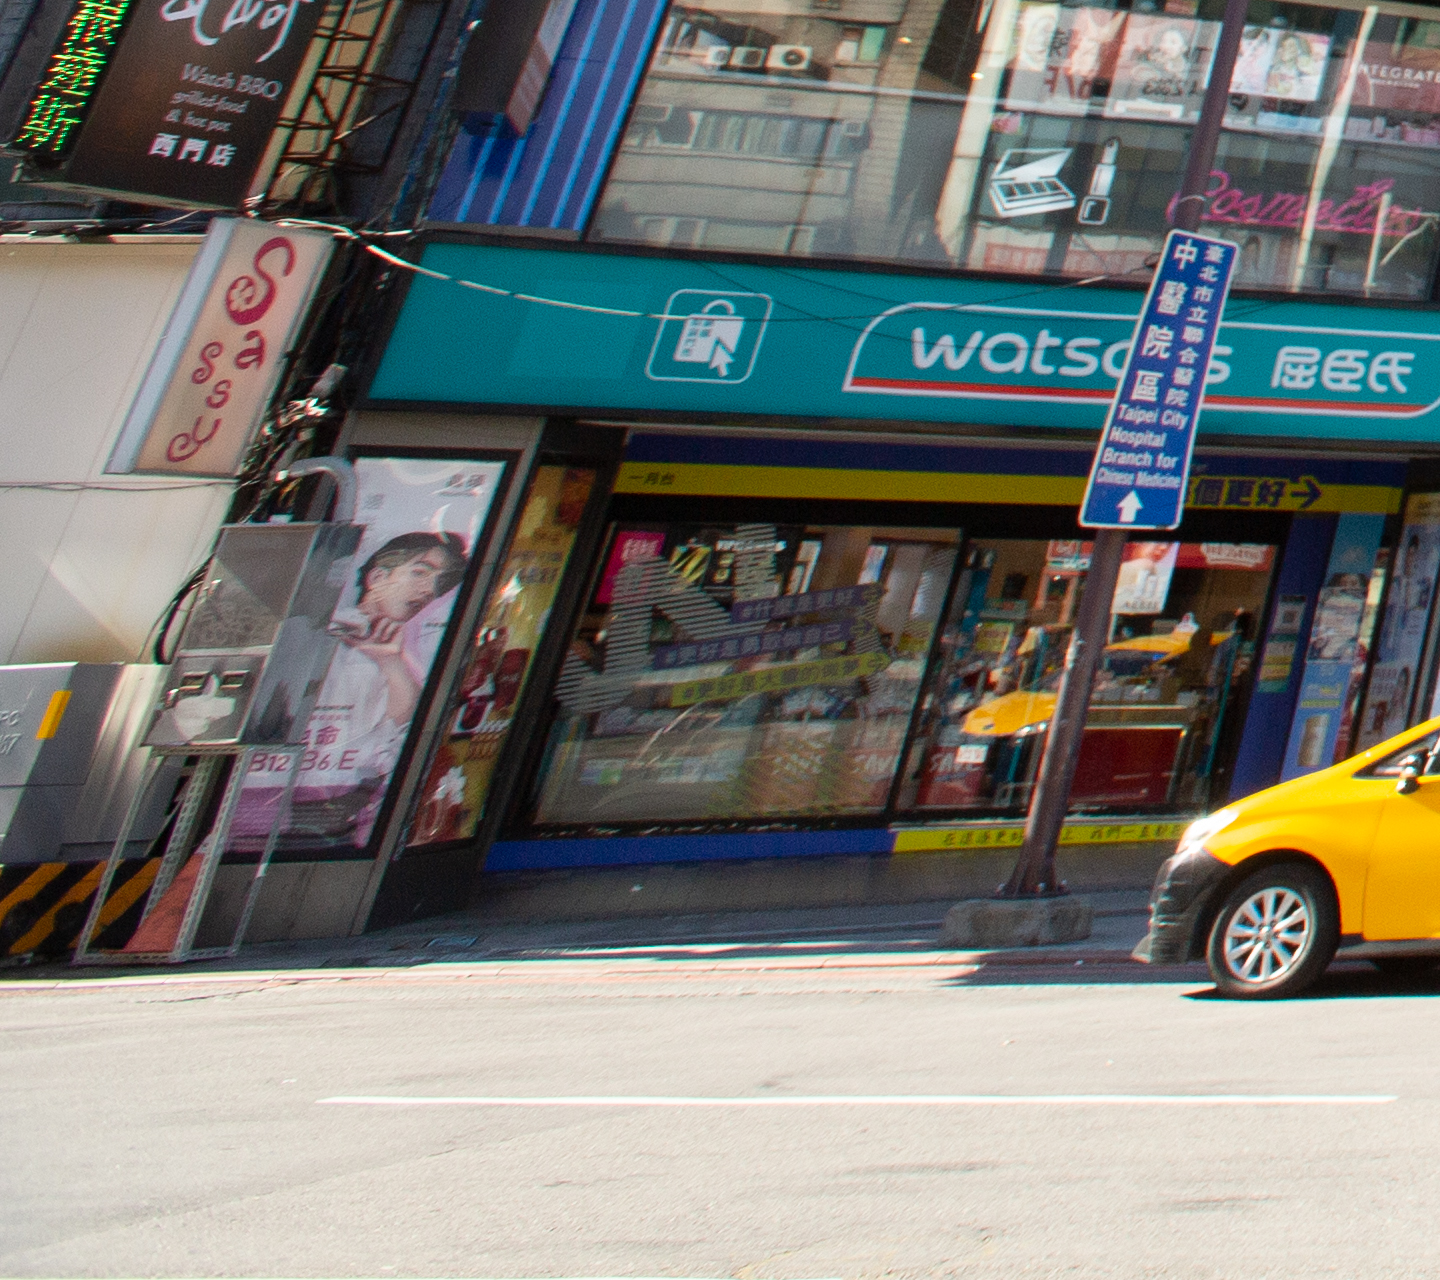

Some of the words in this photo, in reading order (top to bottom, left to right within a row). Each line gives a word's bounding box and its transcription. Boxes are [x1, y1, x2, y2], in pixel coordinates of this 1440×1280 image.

[149, 132, 237, 167] 西門店
[1130, 239, 1198, 402] 中醫院區
[911, 326, 1233, 384] watsos
[1272, 345, 1414, 396] 屈臣氏
[1118, 403, 1158, 426] Taipei
[1161, 408, 1189, 430] City
[1109, 426, 1167, 449] Hospital
[1101, 447, 1153, 468] Branch
[1156, 452, 1178, 469] for
[1186, 477, 1287, 509] 個更好
